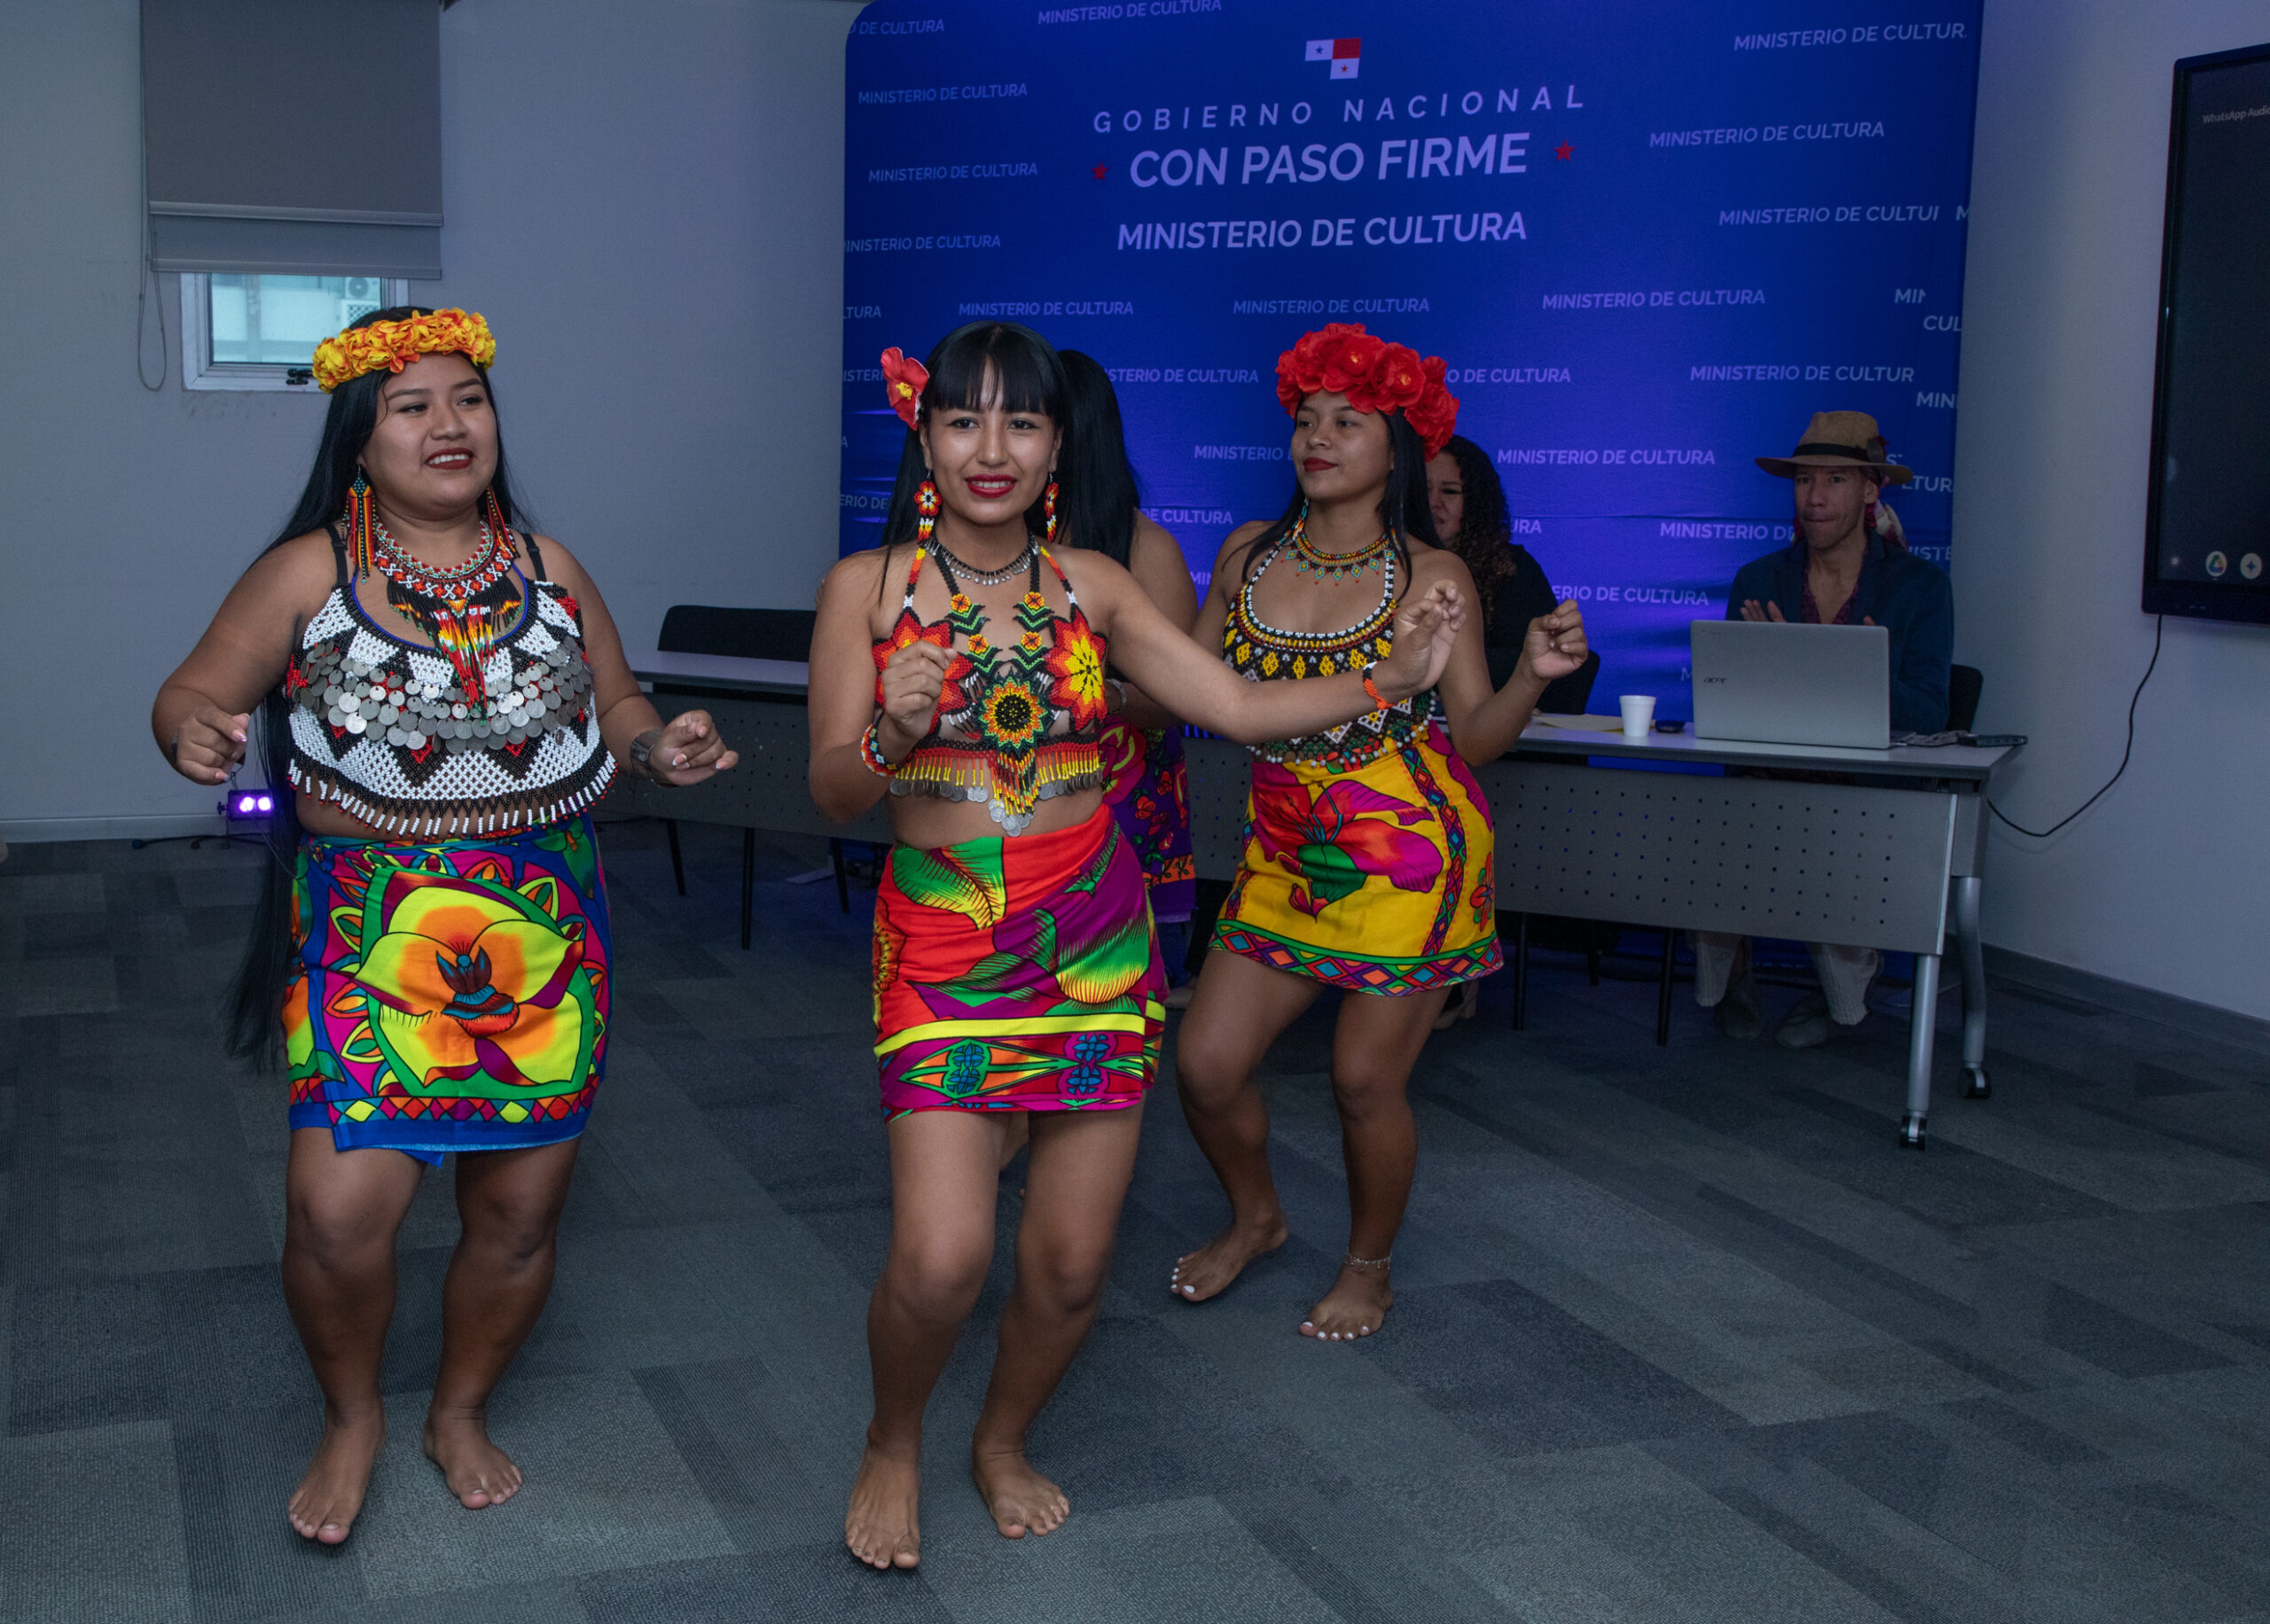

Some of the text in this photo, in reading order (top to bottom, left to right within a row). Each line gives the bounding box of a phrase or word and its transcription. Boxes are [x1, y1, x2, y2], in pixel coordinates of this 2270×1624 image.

[1037, 0, 1221, 24] MINISTERIO DE CULTURA
[859, 22, 878, 35] DE
[881, 19, 944, 35] CULTURA
[1734, 23, 1967, 50] MINISTERIO DE CULTUR
[859, 83, 1028, 104] MINISTERIO DE CULTURA
[1094, 85, 1583, 132] GOBIERNO NACIONAL
[2203, 111, 2247, 123] WhatsApp
[1649, 121, 1884, 147] MINISTERIO DE CULTURA
[1131, 132, 1530, 187] CON PASO FIRME
[869, 163, 1037, 182] MINISTERIO DE CULTURA
[1719, 207, 1829, 225] MINISTERIO
[1836, 207, 1861, 222] DE
[1118, 212, 1526, 249] MINISTERIO DE CULTURA
[916, 237, 933, 249] DE
[937, 235, 1000, 248] CULTURA
[1233, 298, 1429, 314] MINISTERIO DE CULTURA
[1543, 290, 1765, 308] MINISTERIO DE CULTURA
[844, 306, 881, 318] TURA
[959, 301, 1133, 316] MINISTERIO DE CULTURA
[1106, 369, 1258, 382] STERIO DE CULTURA
[1464, 369, 1487, 383] DE
[1491, 368, 1570, 383] CULTURA
[1690, 365, 1914, 382] MINISTERIO DE CULTUR
[1194, 445, 1282, 459] MINISTERIO
[1498, 449, 1715, 465] MINISTERIO DE CULTURA
[1162, 510, 1233, 524] CULTURA
[1660, 523, 1767, 539] MINISTERIO
[1597, 587, 1619, 602] DE
[1624, 589, 1709, 605] CULTURA
